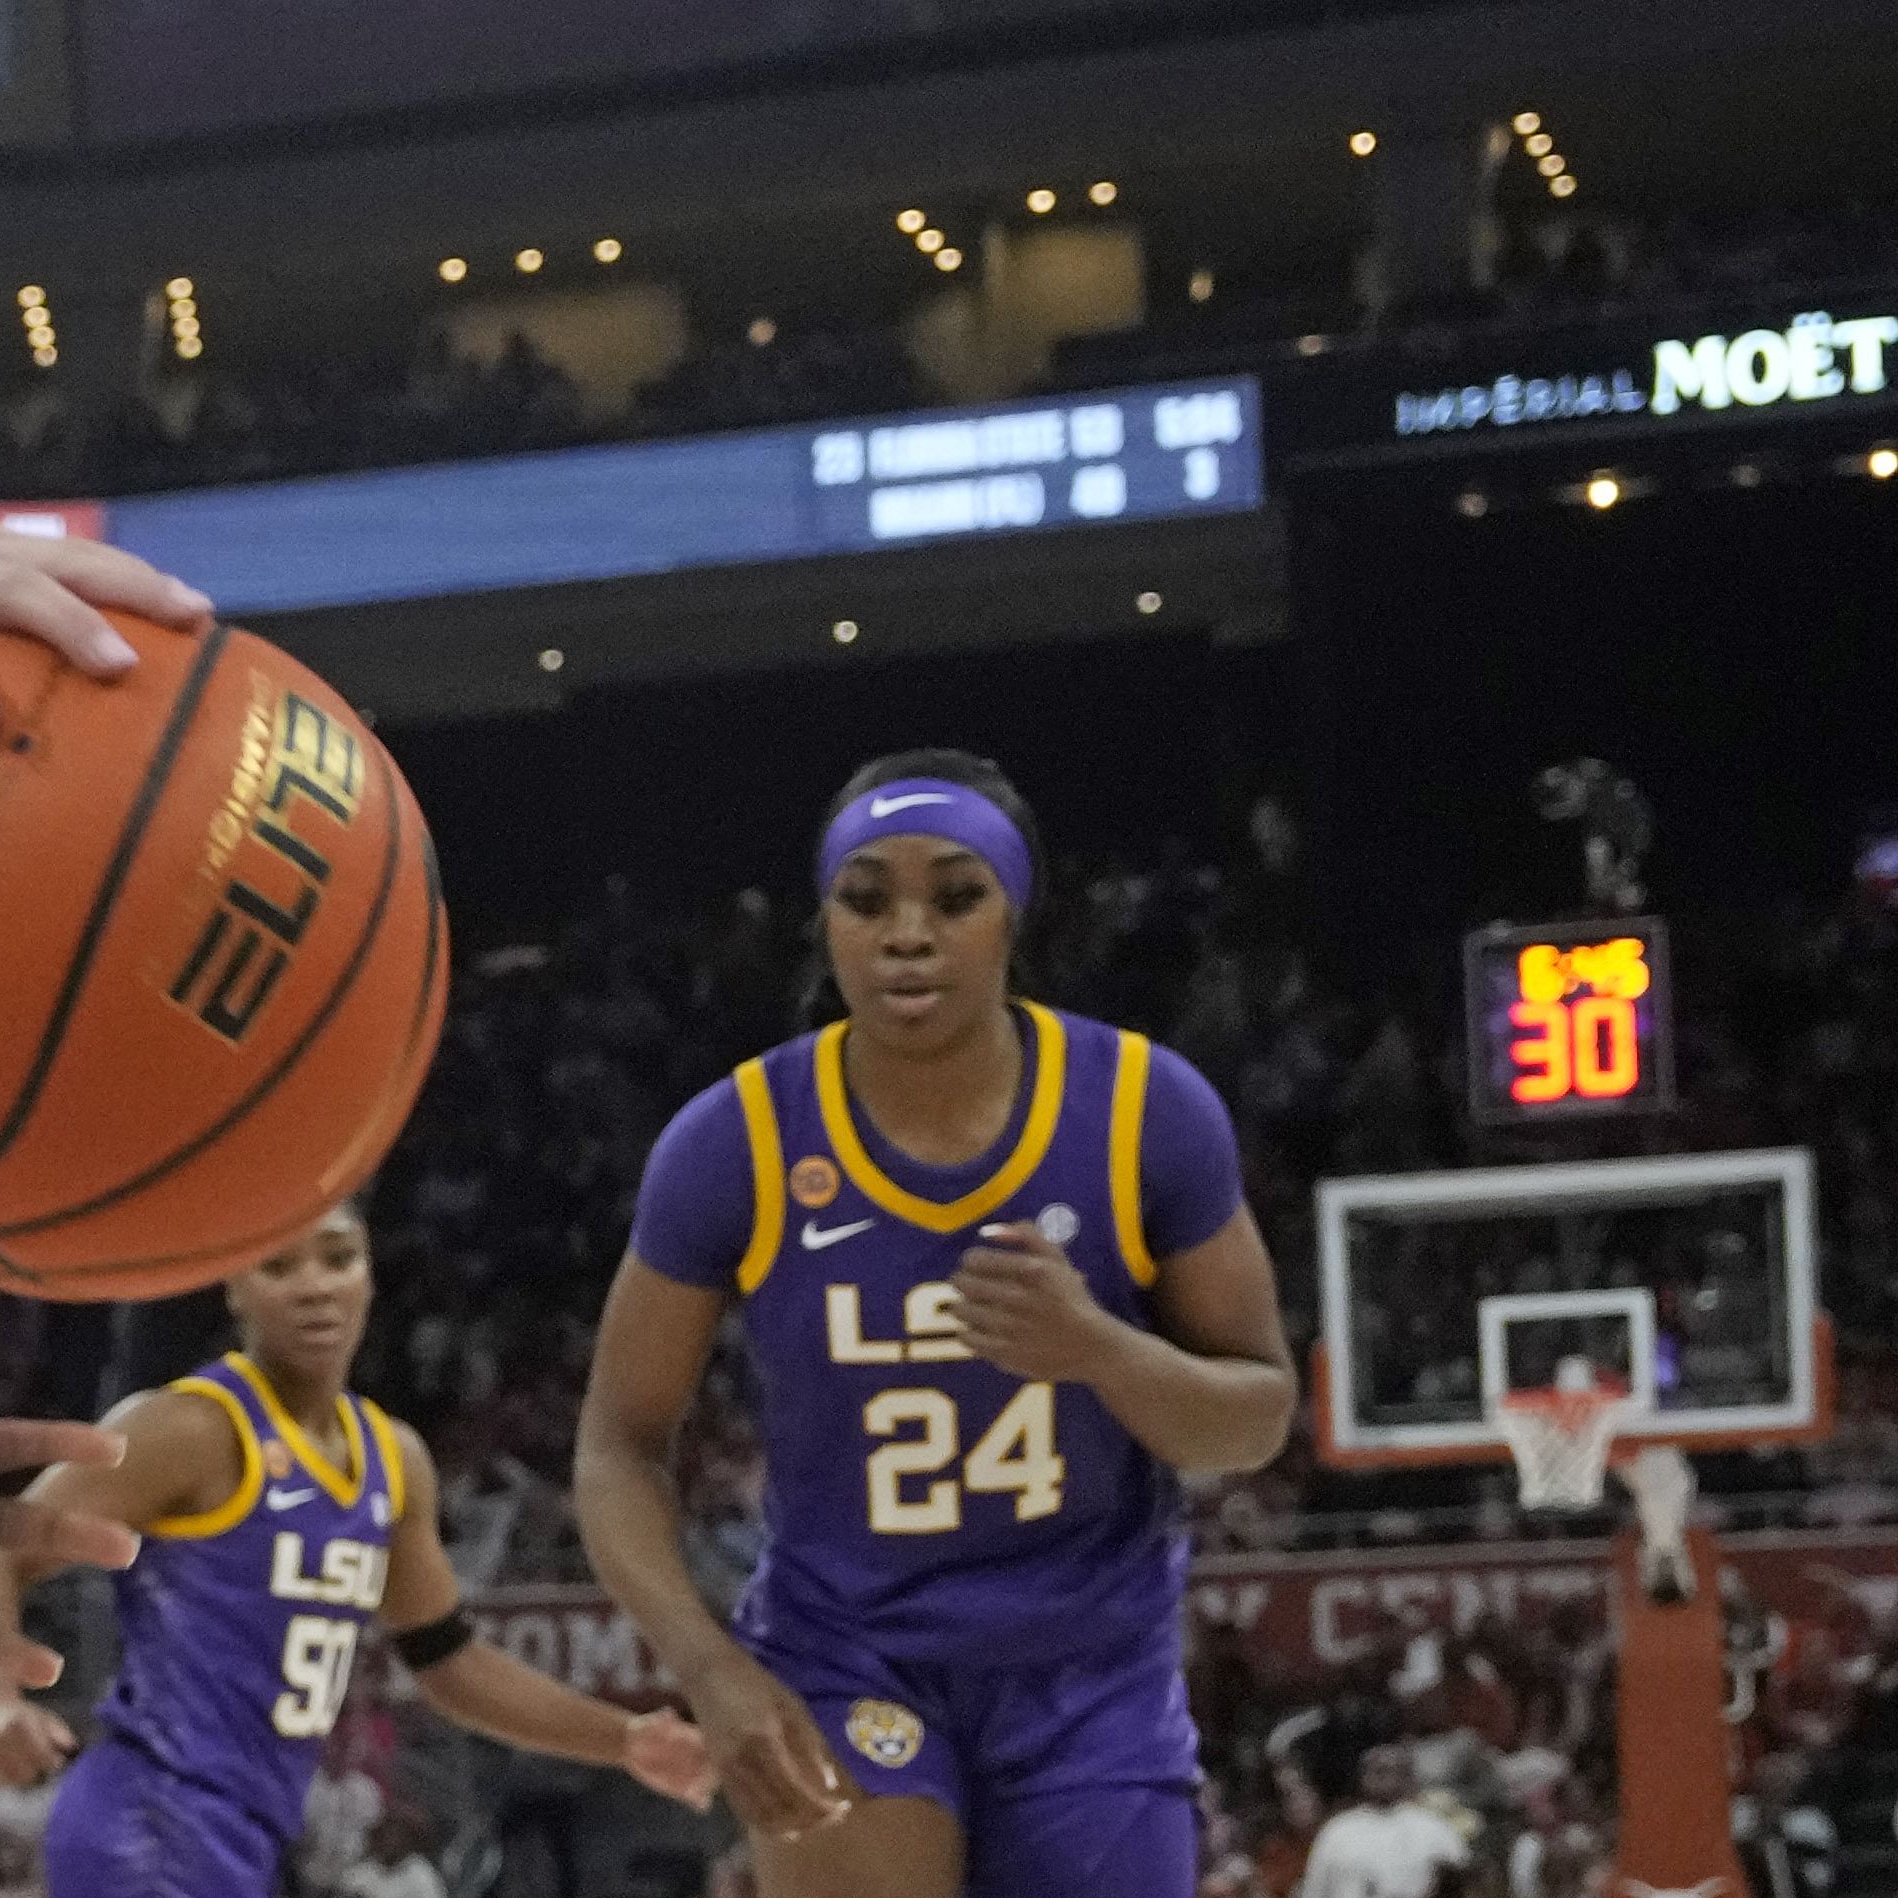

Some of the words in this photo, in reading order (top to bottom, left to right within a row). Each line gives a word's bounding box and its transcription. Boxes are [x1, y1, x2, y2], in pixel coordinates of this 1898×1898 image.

[1650, 310, 1898, 416] MOËT
[166, 690, 367, 1046] ELITE
[1508, 996, 1640, 1103] 30
[825, 1281, 978, 1365] LS
[862, 1380, 1067, 1535] 24
